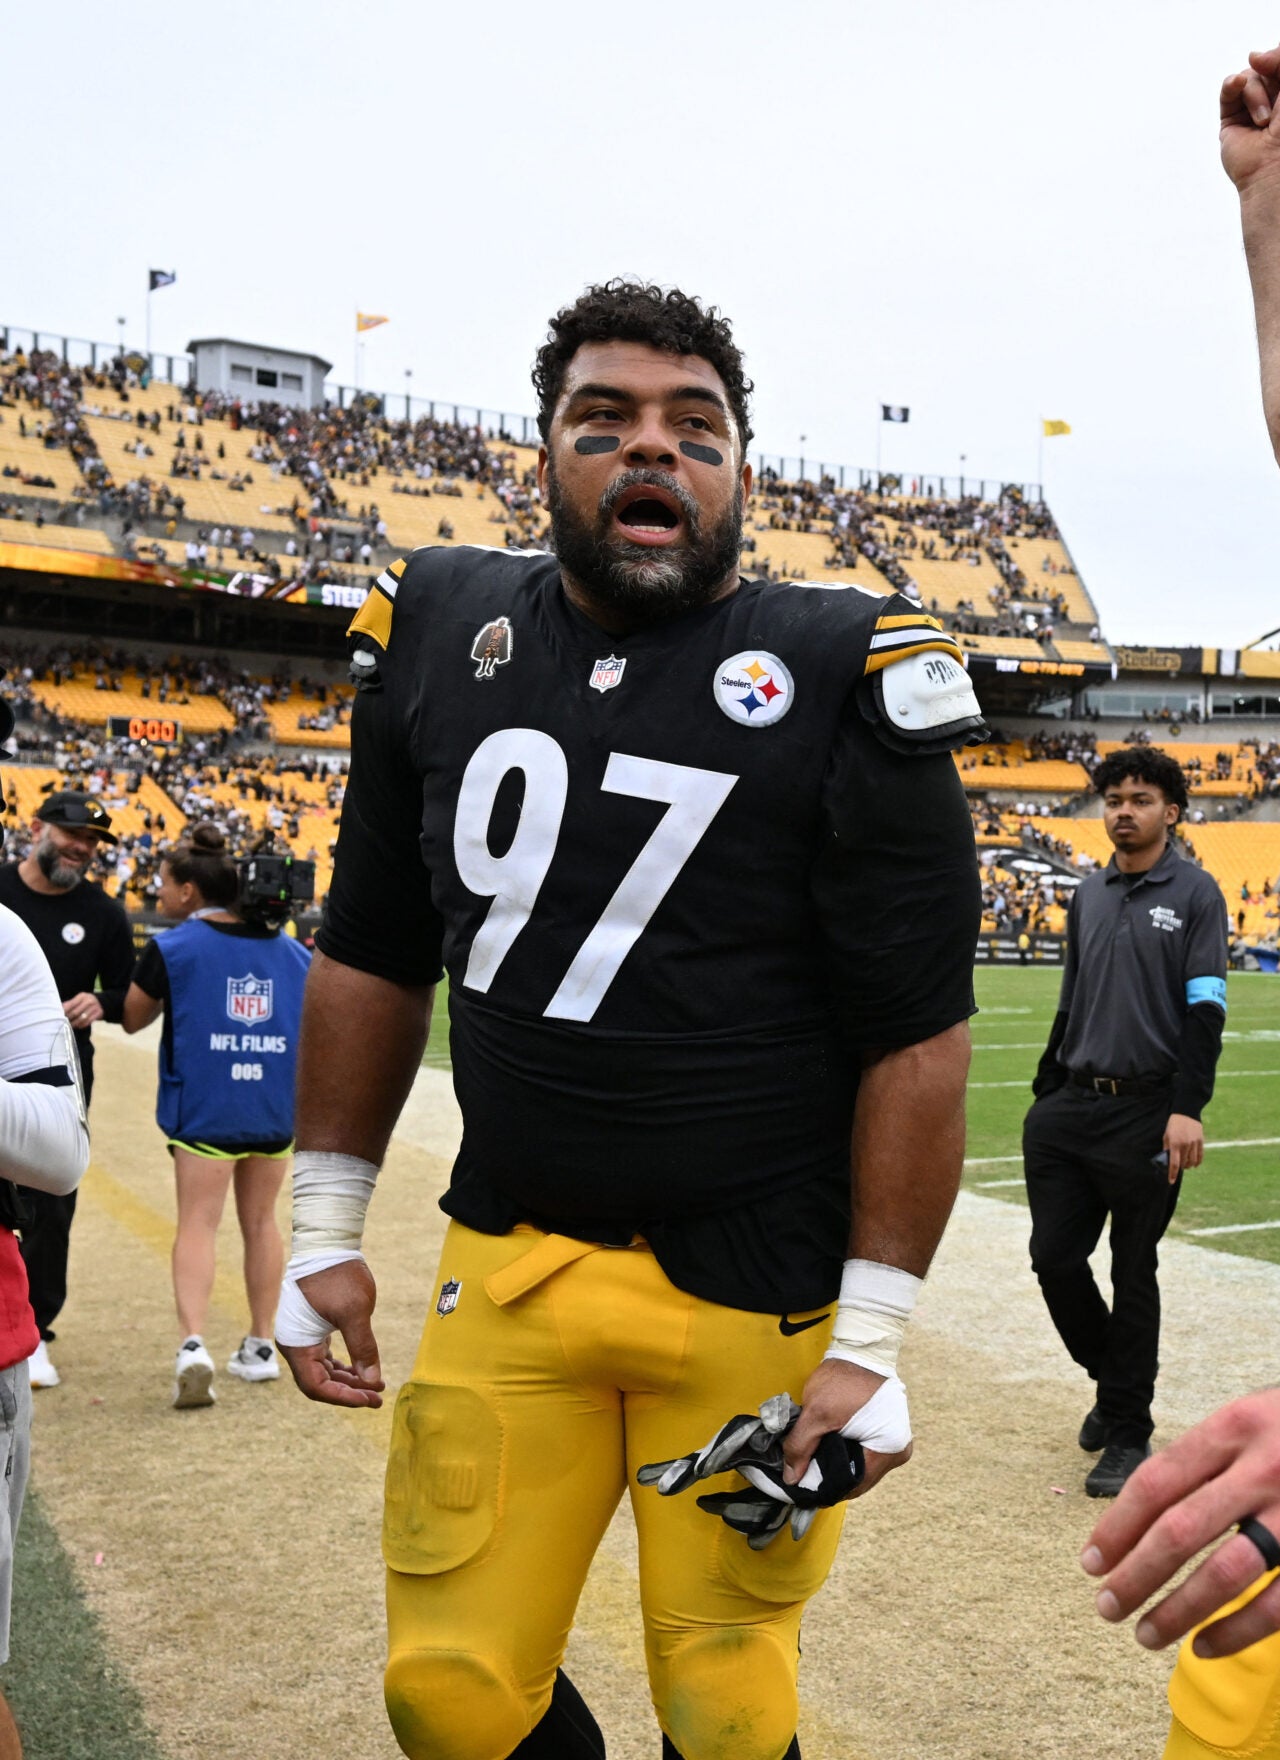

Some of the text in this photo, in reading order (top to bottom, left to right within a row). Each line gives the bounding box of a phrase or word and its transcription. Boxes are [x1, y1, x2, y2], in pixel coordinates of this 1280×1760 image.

[595, 671, 616, 686] NFL
[721, 676, 752, 690] Steelers
[453, 728, 740, 1022] 97
[233, 996, 267, 1018] NFL
[210, 1033, 287, 1054] NFL FILMS
[231, 1062, 264, 1081] 005
